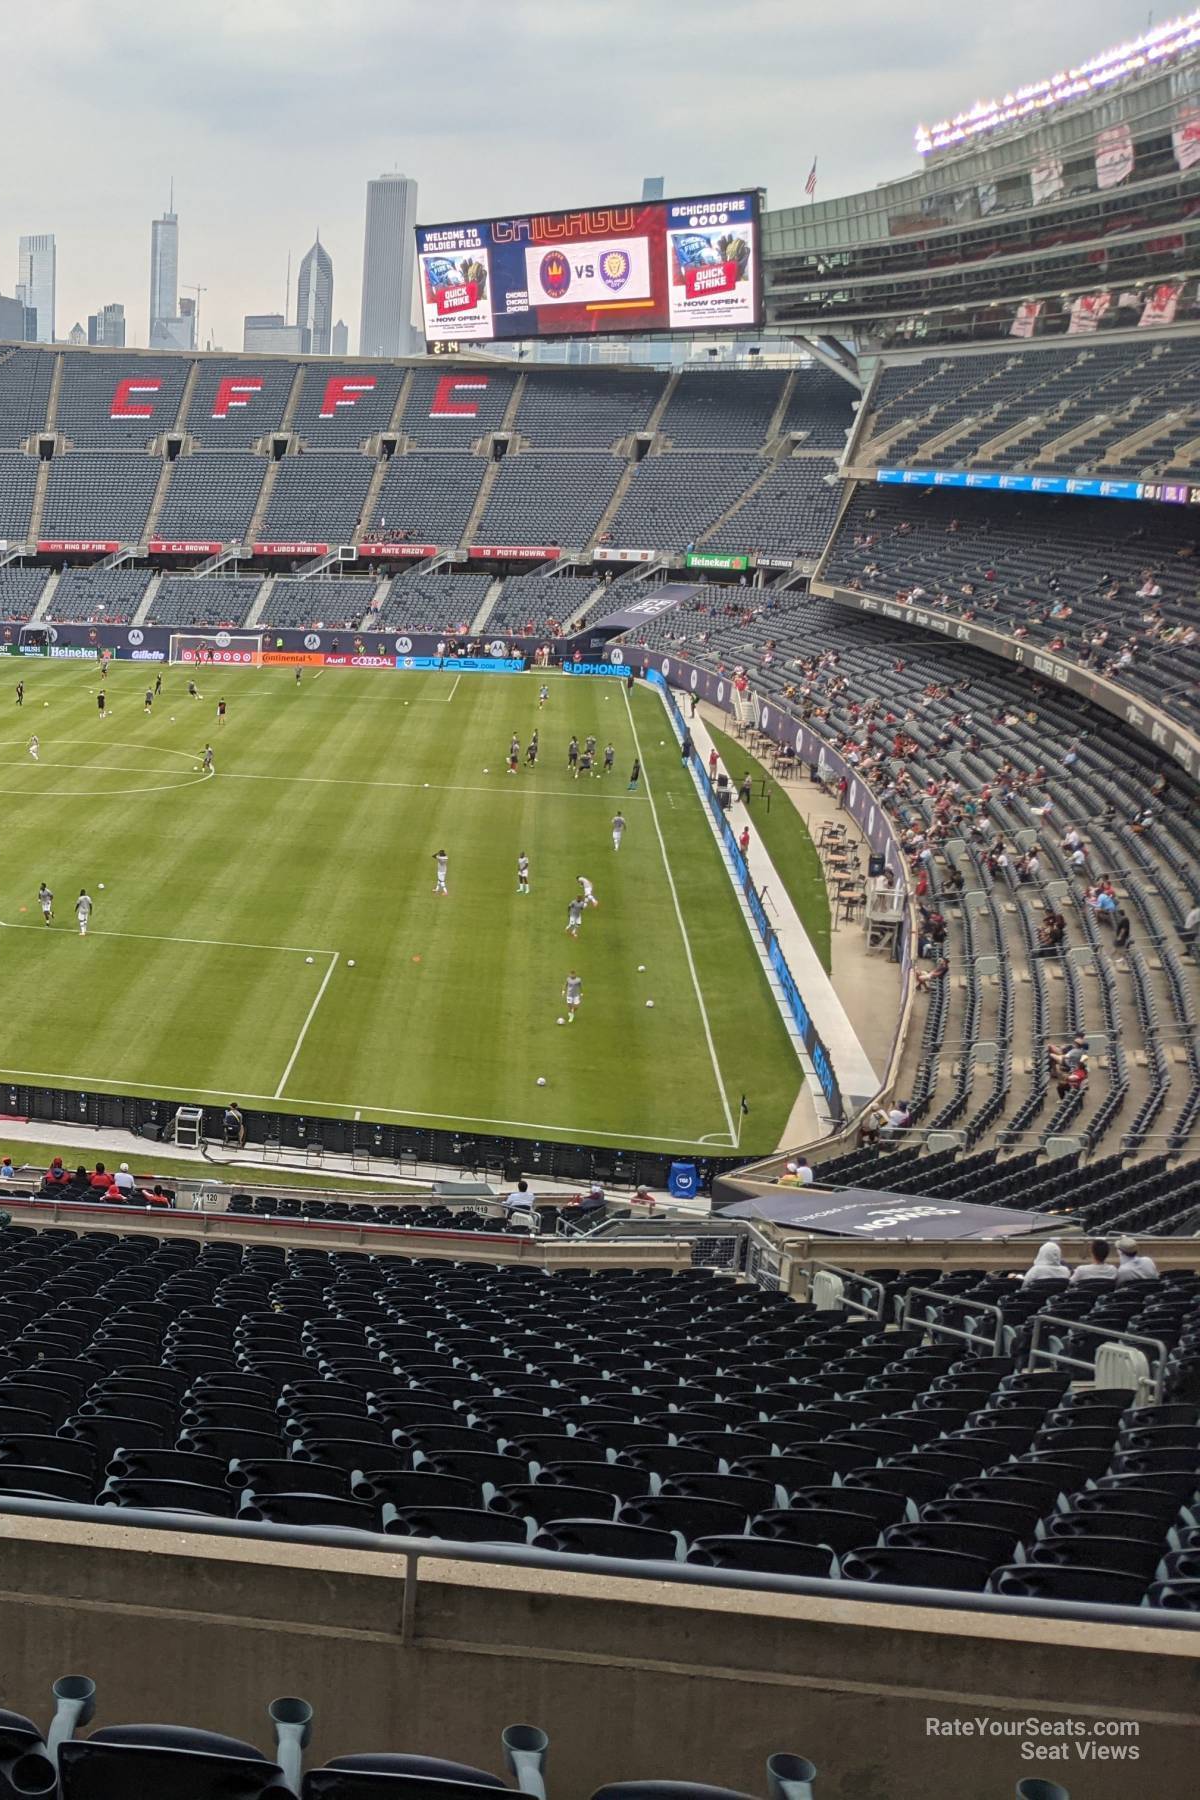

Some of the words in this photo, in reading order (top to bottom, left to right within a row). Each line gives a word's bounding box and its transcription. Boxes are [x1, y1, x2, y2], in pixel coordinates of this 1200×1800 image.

[425, 231, 465, 242] WELCOME
[466, 228, 478, 238] TO
[423, 240, 457, 252] SOLDIER
[458, 238, 482, 248] FIELD
[574, 264, 595, 279] VS
[696, 267, 725, 281] QUICK
[694, 276, 727, 291] STRIKE
[444, 287, 468, 300] QUICK
[443, 295, 470, 308] STRIKE
[711, 298, 739, 306] OPEN
[436, 315, 456, 323] NOW
[433, 341, 458, 354] 2:14
[691, 556, 731, 567] Heineken
[262, 653, 306, 663] Continental
[326, 655, 347, 664] Audi
[206, 1193, 218, 1202] 120
